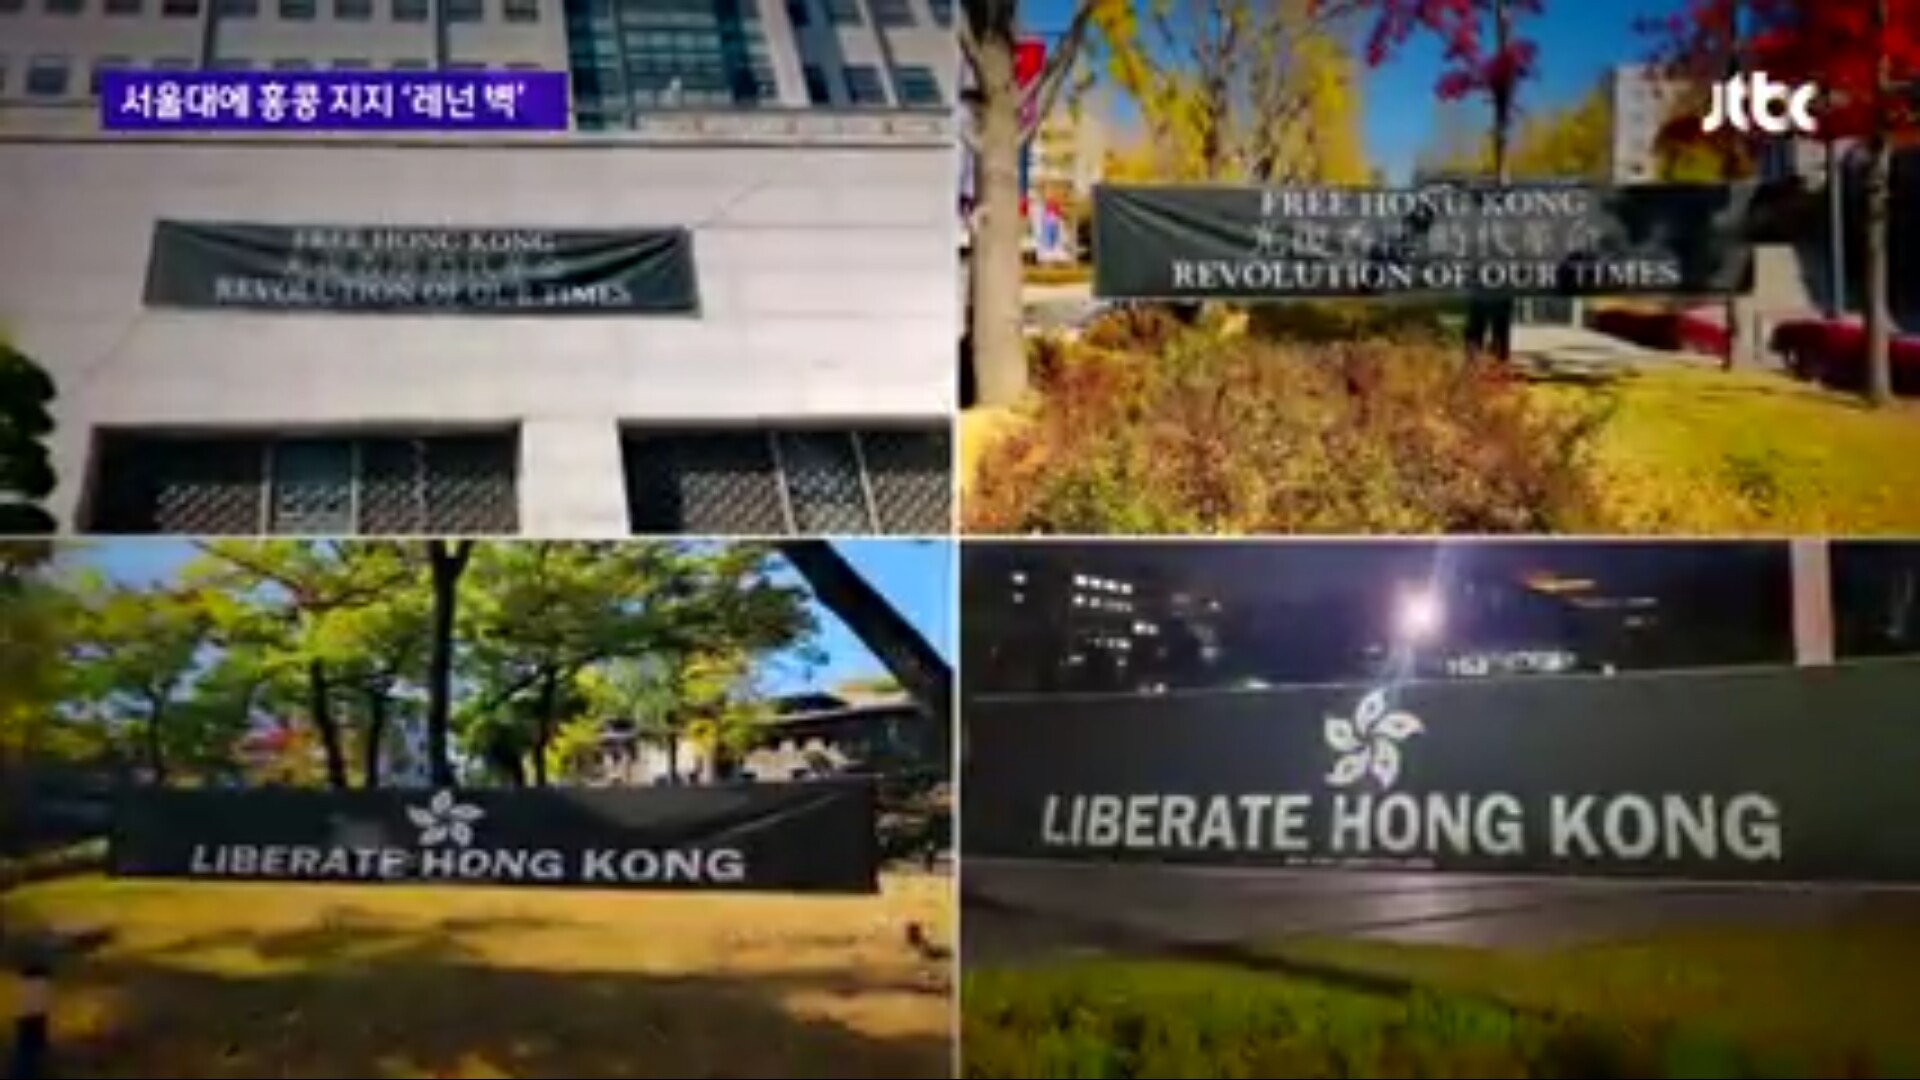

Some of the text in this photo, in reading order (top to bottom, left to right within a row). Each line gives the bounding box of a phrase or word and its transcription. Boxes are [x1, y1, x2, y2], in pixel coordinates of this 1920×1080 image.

[1260, 190, 1353, 217] FREE
[1480, 191, 1588, 218] KONG
[1172, 260, 1681, 289] REVOLUTION OF OUR TIMES
[1041, 794, 1781, 860] LIBERATE HONG KONG
[190, 845, 746, 882] LIBERATE HONG KONG
